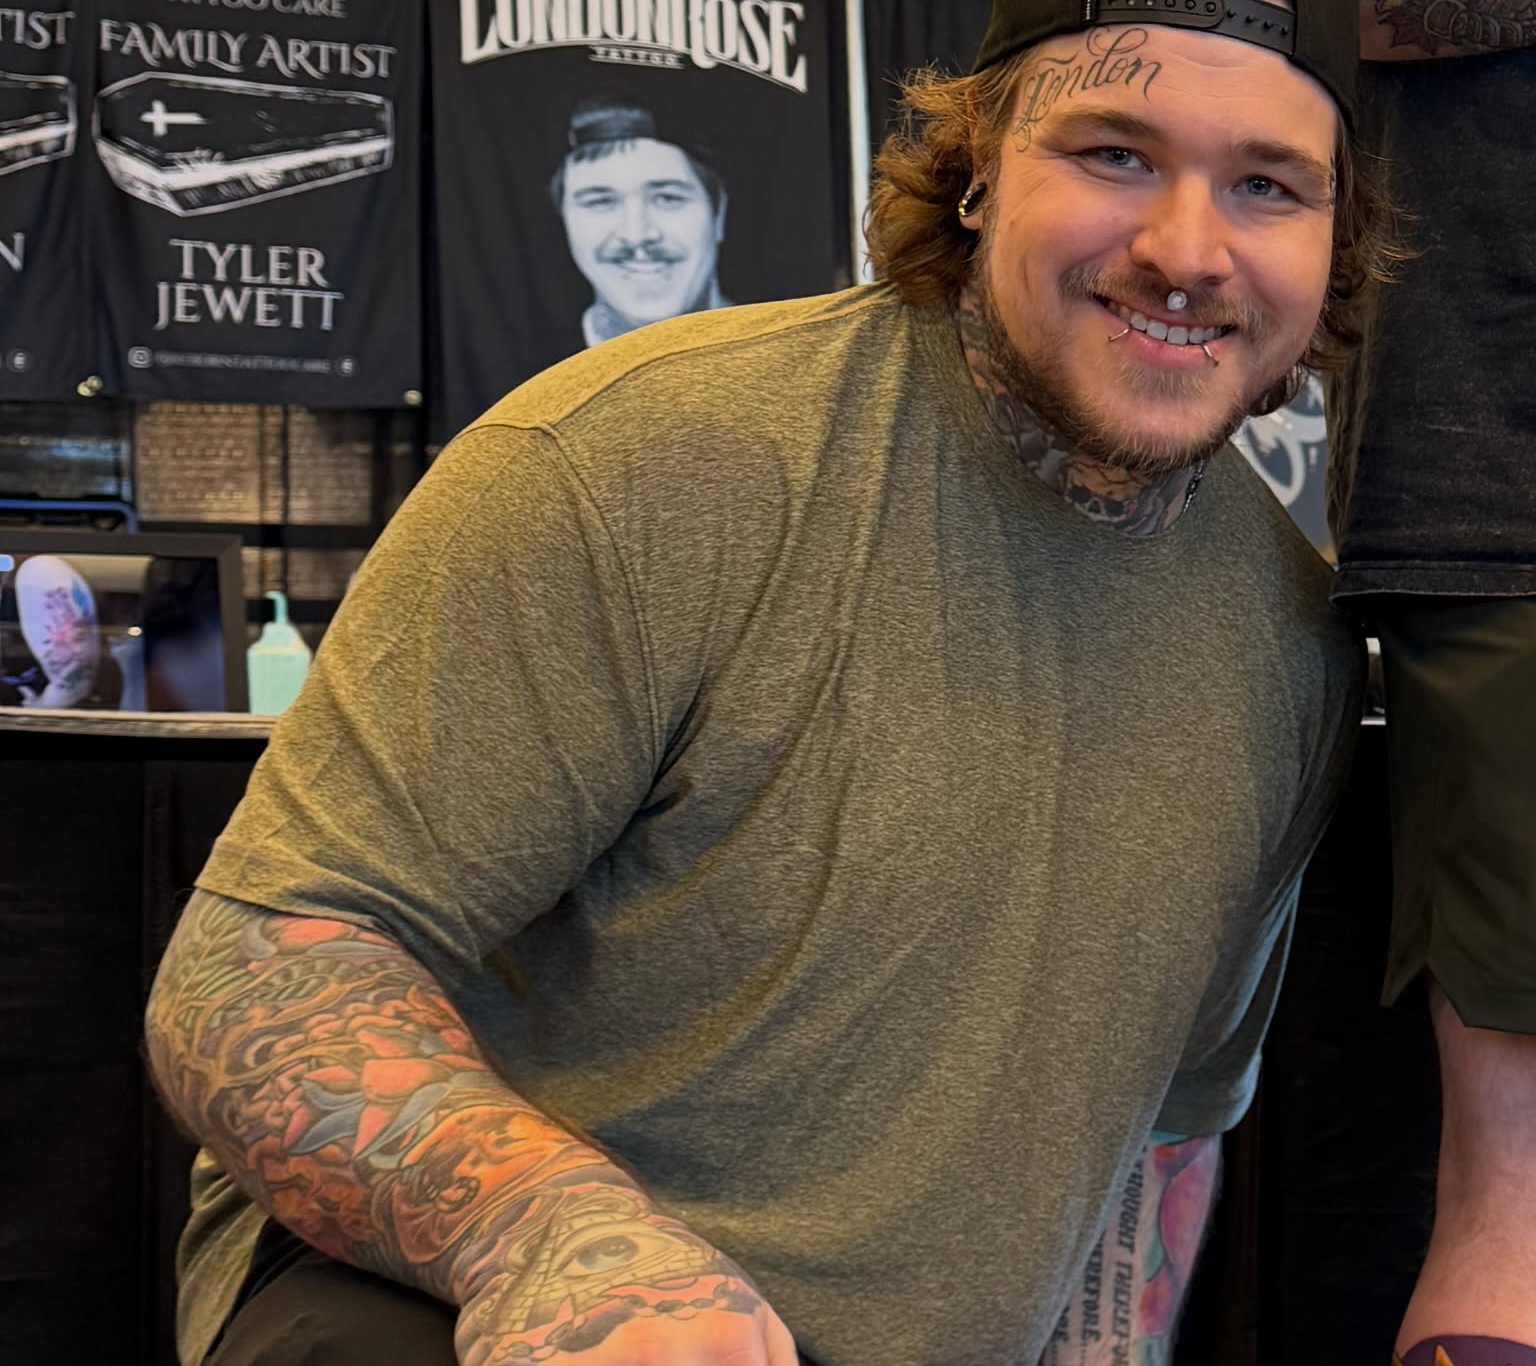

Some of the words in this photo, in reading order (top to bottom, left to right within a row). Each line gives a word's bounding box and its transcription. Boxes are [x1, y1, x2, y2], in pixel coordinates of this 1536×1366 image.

[100, 19, 247, 73] FAMILY
[256, 34, 397, 79] ARTIST
[169, 238, 330, 288] TYLER
[153, 281, 345, 331] JEWETT
